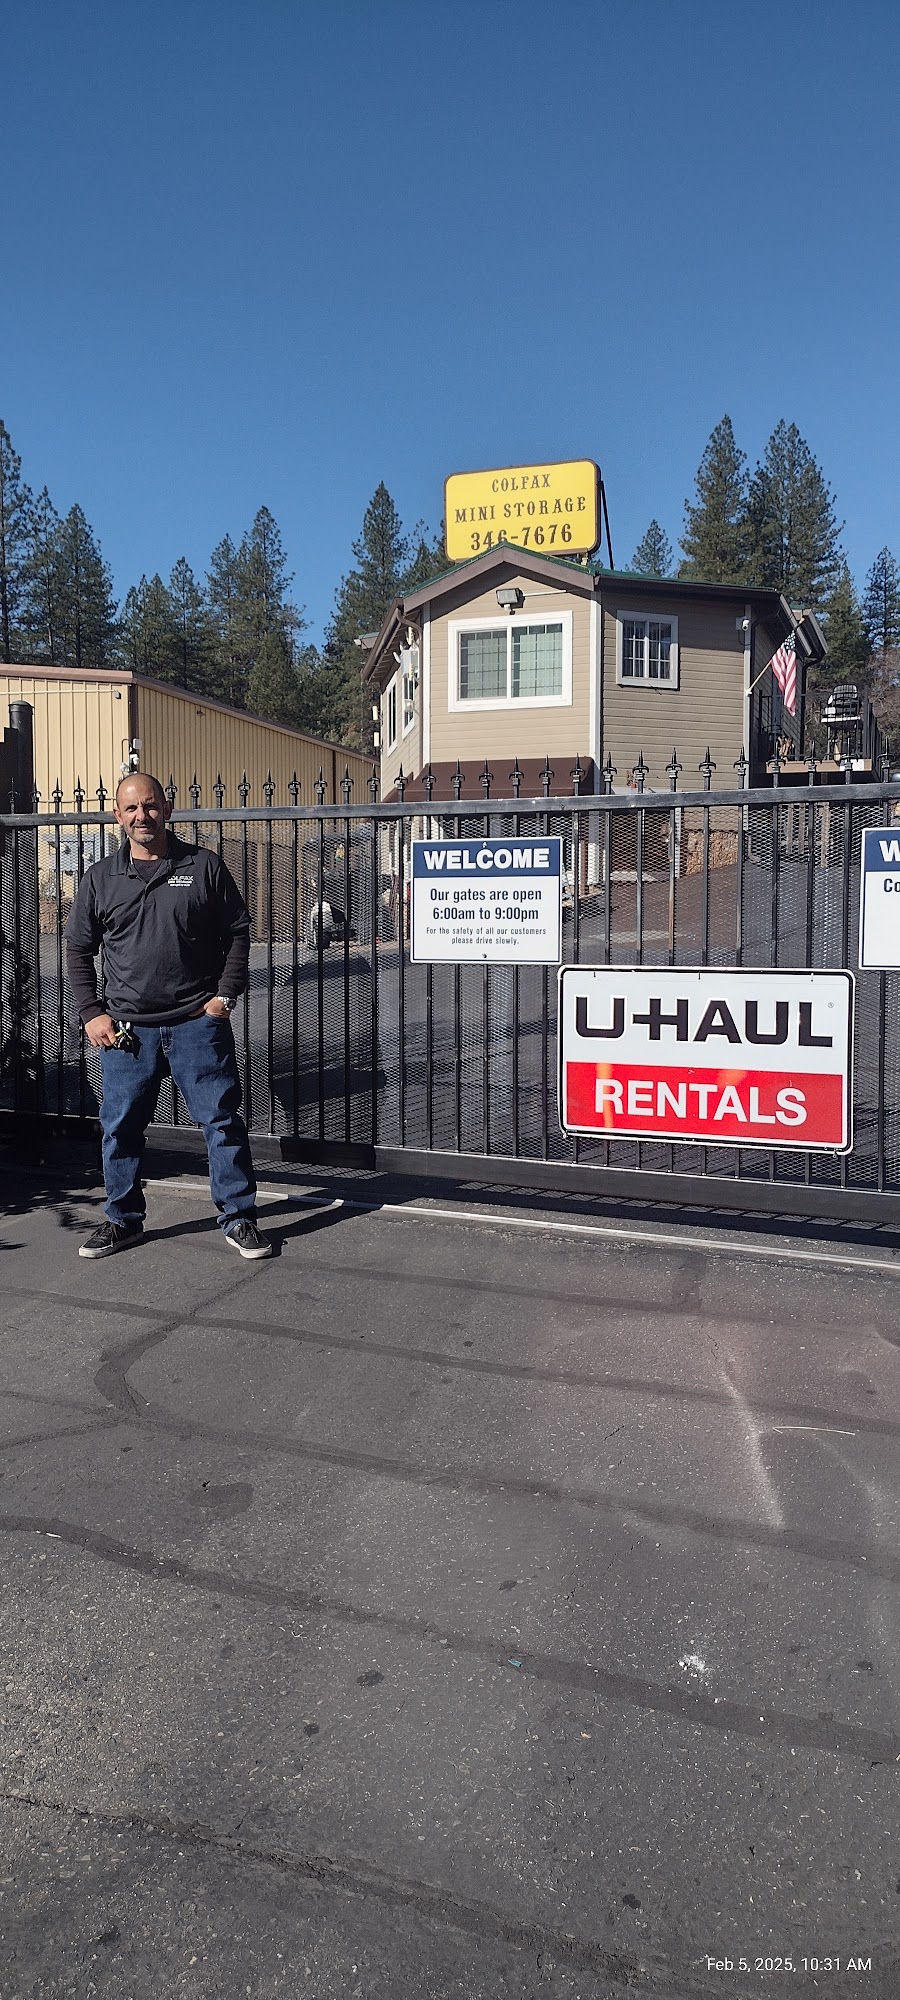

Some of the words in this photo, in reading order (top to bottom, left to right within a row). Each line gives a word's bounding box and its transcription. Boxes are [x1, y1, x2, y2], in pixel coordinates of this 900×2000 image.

[491, 474, 551, 492] COLFAX
[455, 505, 496, 523] MINI
[503, 496, 586, 518] STORAGE
[470, 523, 573, 551] 346-7676
[423, 848, 550, 870] WELCOME
[430, 888, 450, 901] Our
[453, 889, 486, 903] gates
[489, 891, 509, 900] are
[512, 890, 542, 903] open
[432, 907, 475, 920] 6:00am
[479, 907, 491, 920] to
[494, 907, 539, 922] 9:00pm
[426, 927, 437, 935] For
[439, 927, 450, 935] the
[452, 926, 473, 936] safety
[476, 927, 483, 935] of
[485, 927, 494, 935] all
[510, 927, 547, 935] customers
[451, 937, 473, 945] please
[495, 937, 520, 946] slowly.
[575, 996, 834, 1048] U-HAUL
[594, 1078, 808, 1127] RENTALS
